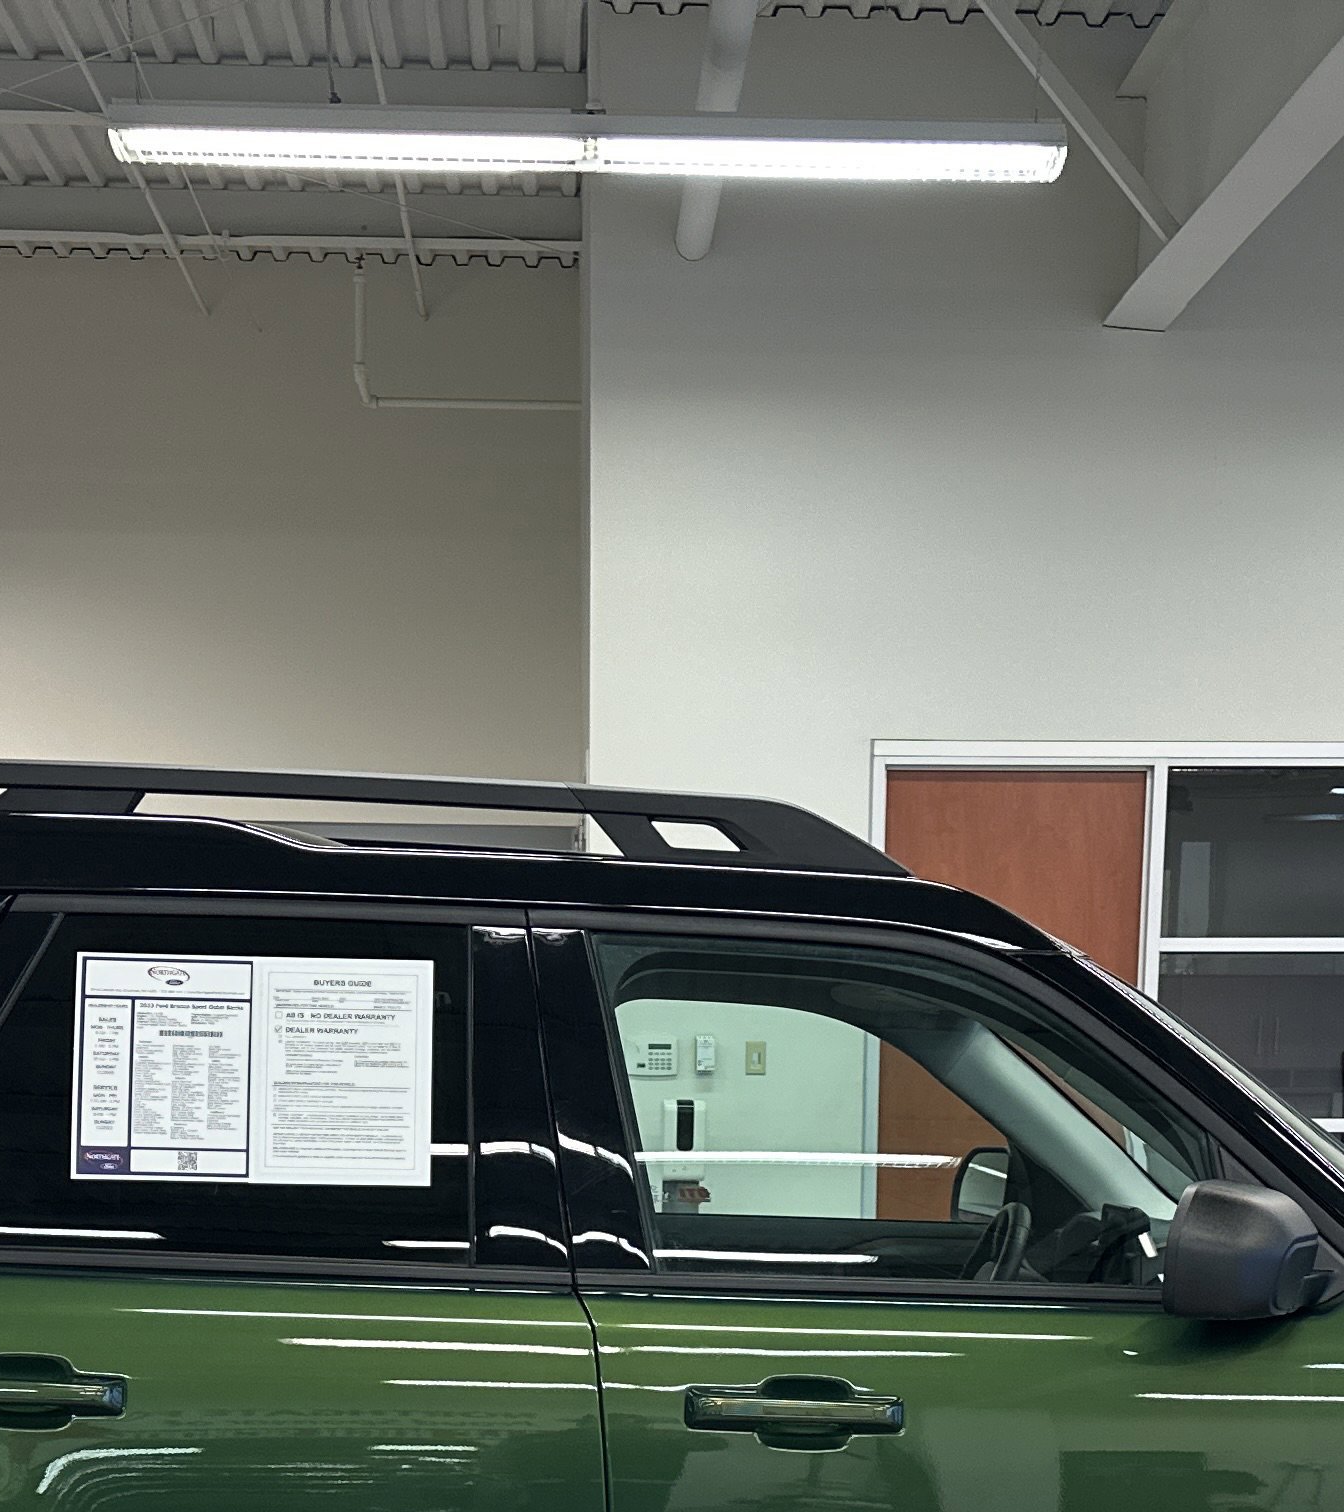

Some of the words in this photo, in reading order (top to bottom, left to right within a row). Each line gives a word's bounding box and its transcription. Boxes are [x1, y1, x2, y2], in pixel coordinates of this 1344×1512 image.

[313, 979, 346, 987] BUYERS
[348, 980, 372, 988] GUIDE
[354, 1013, 396, 1021] WARRANTY
[285, 1026, 315, 1034] DEALER
[316, 1027, 359, 1035] WARRANTY
